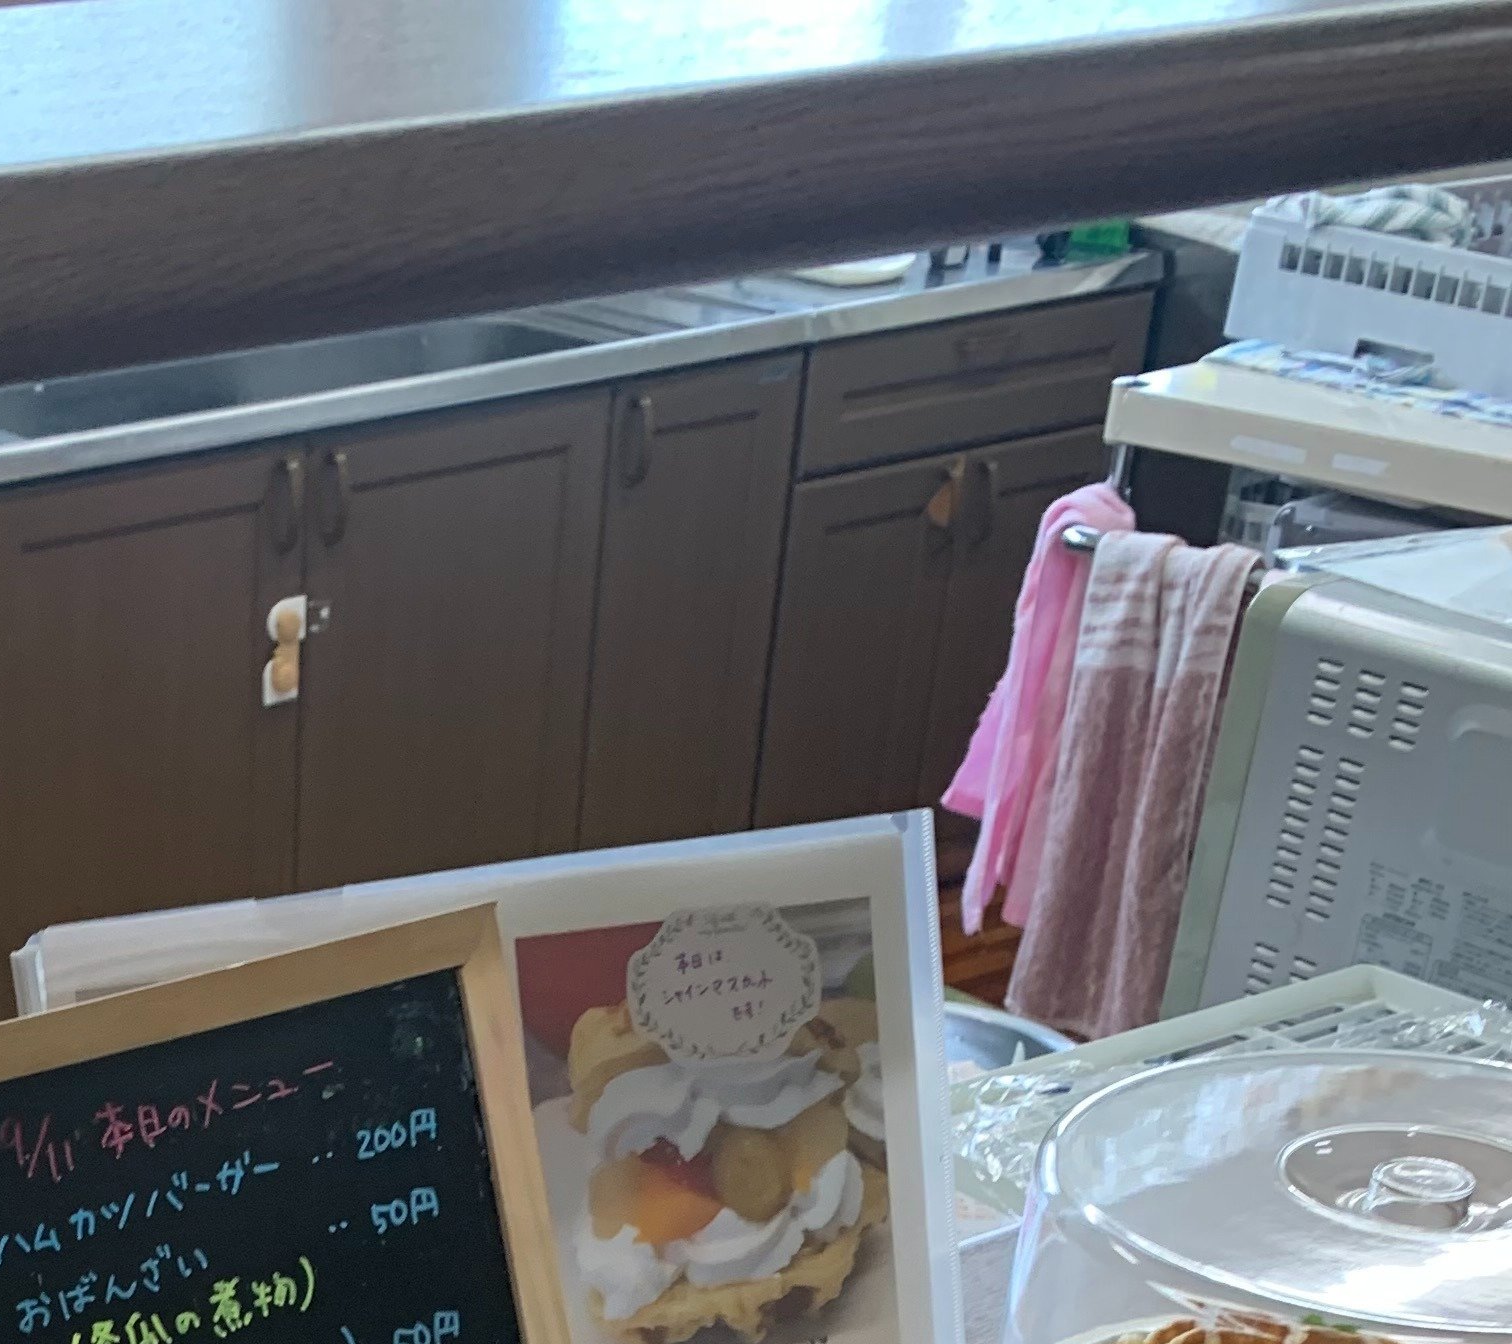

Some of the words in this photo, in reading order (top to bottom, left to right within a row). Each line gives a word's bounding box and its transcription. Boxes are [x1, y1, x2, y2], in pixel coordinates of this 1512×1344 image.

[674, 950, 723, 975] 本日は
[96, 1060, 334, 1159] 本日のメニュー
[356, 1107, 438, 1160] 200円
[15, 1244, 208, 1335] おばんざい
[370, 1186, 440, 1234] 50円
